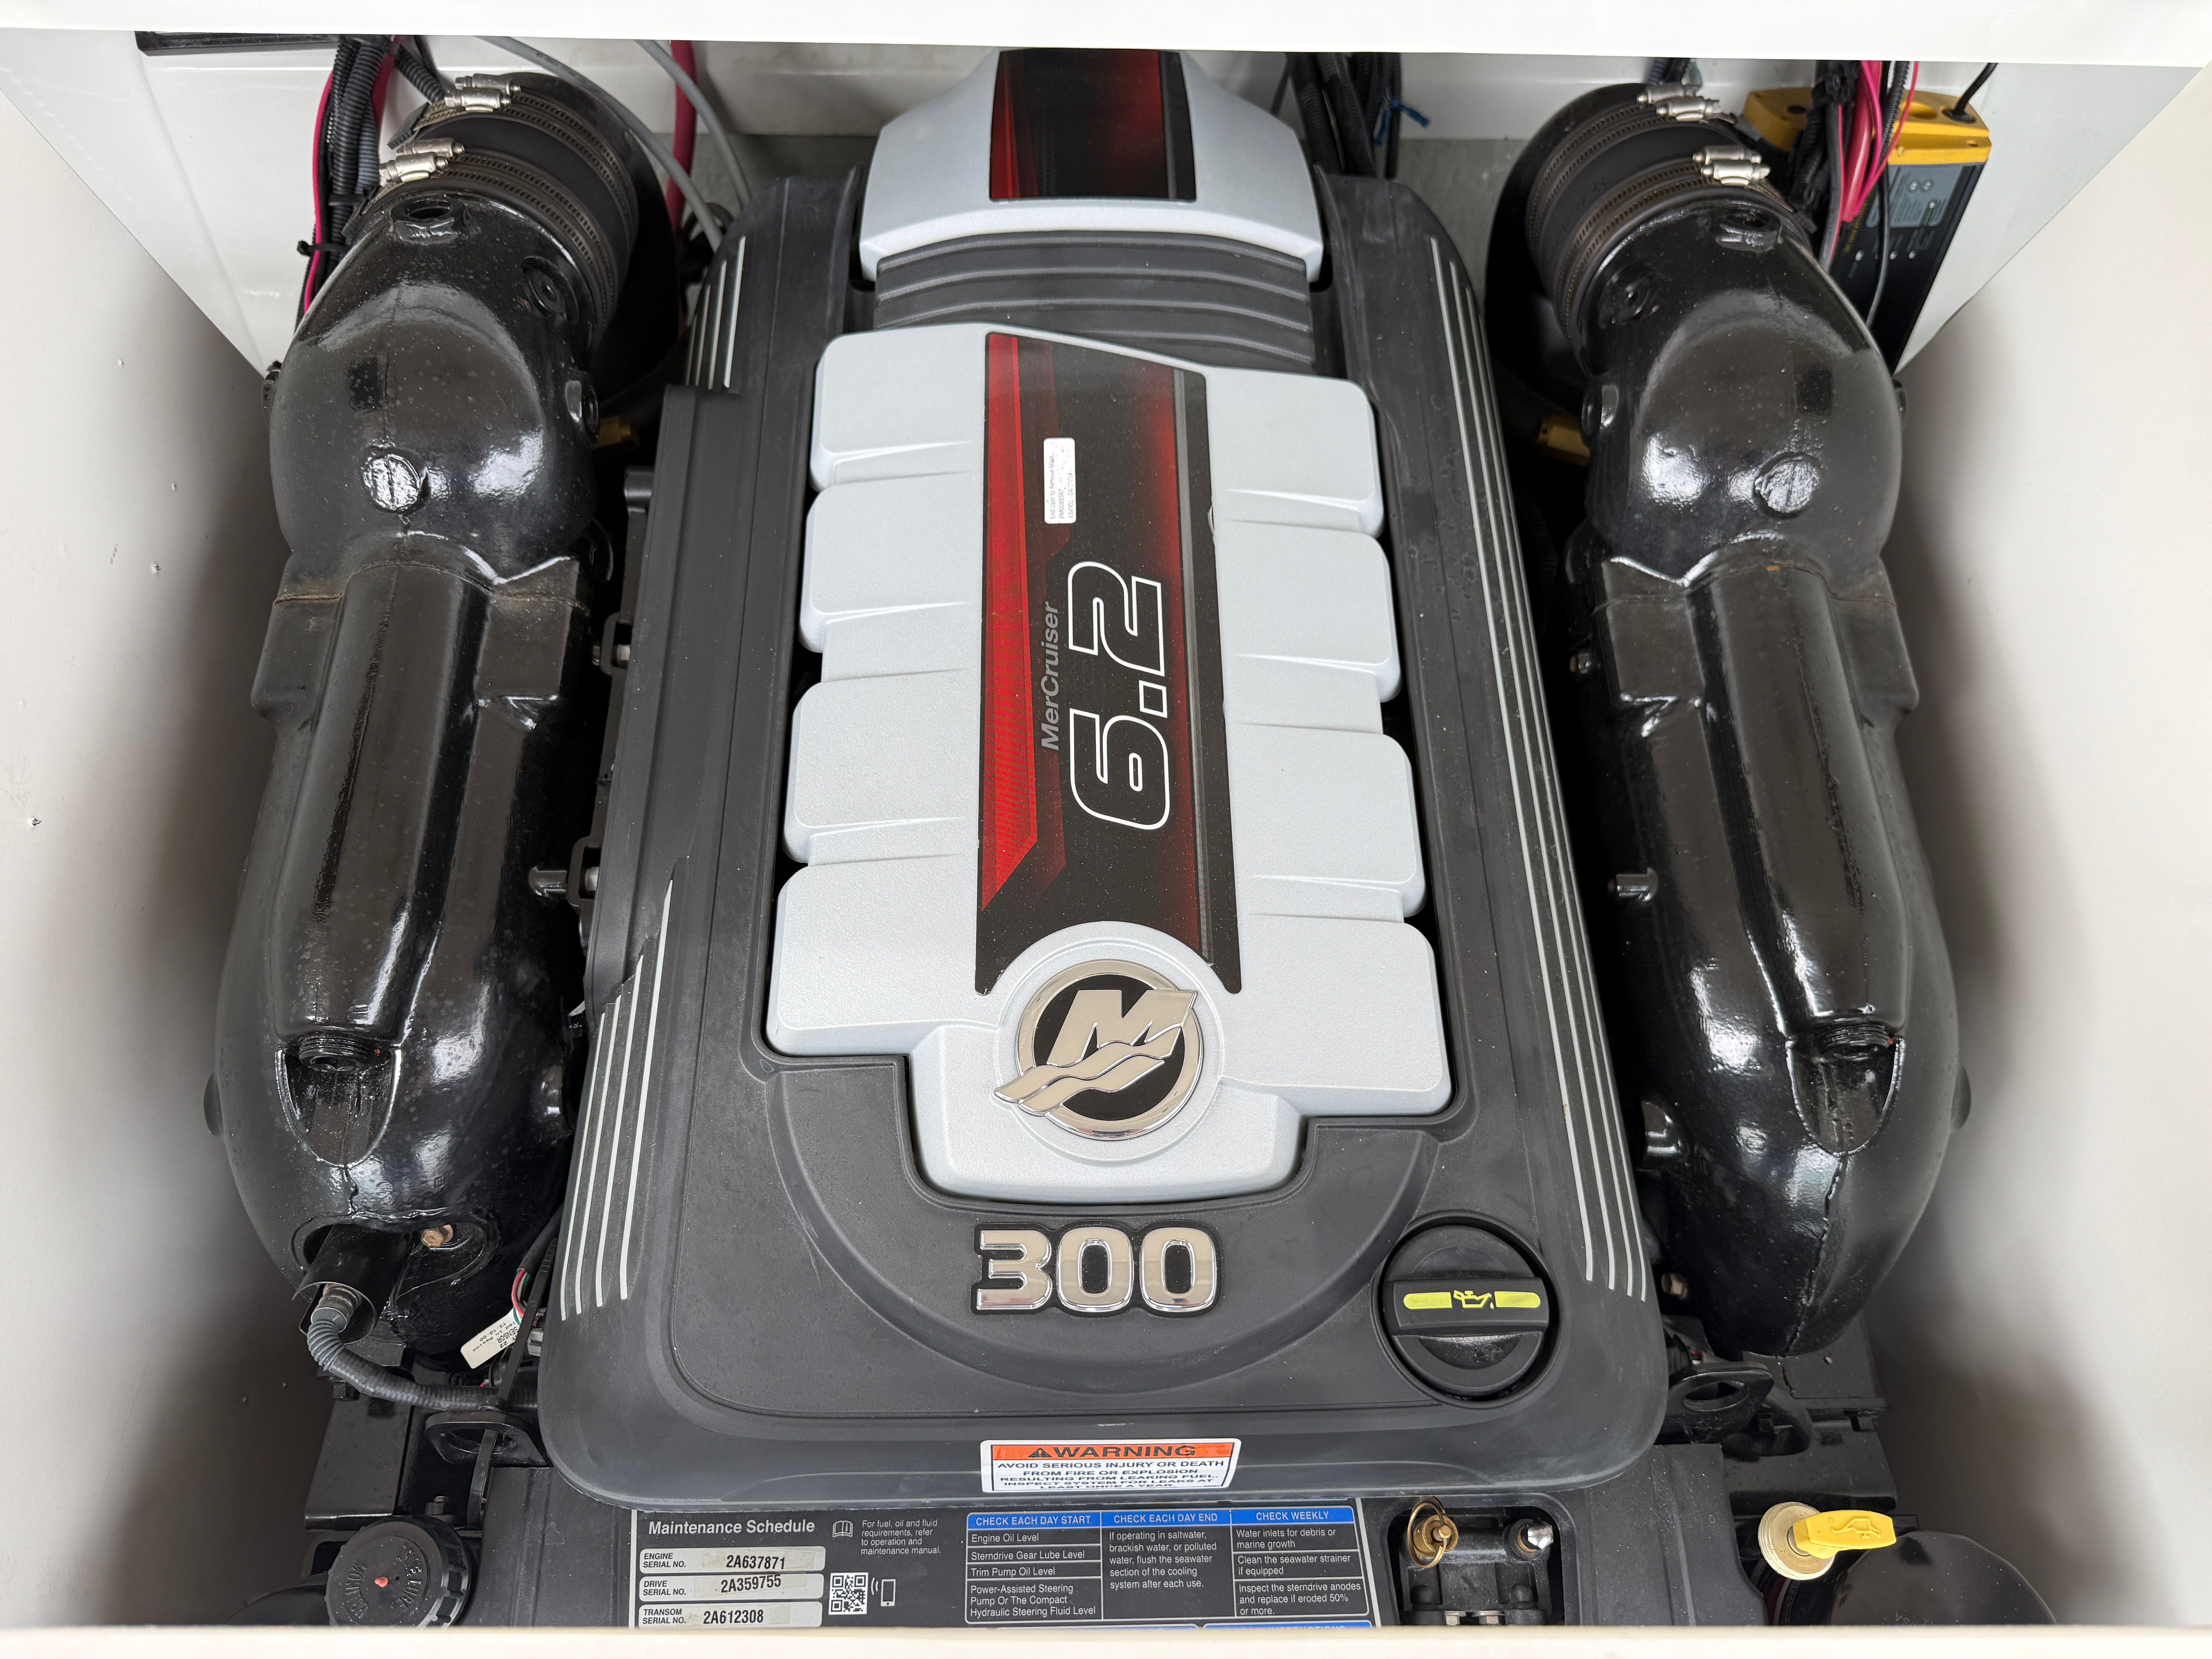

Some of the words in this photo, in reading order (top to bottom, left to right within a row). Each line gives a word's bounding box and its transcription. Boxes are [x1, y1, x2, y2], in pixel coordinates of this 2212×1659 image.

[1041, 601, 1059, 751] MerCruiser
[1067, 561, 1170, 830] 6.2
[975, 1225, 1219, 1314] 300
[497, 1327, 519, 1343] SENSOR
[1053, 1446, 1196, 1457] WARNING
[976, 1517, 1008, 1525] CHECK
[1012, 1516, 1037, 1525] EACH
[1061, 1516, 1091, 1524] START
[1114, 1515, 1146, 1523] CHECK
[1149, 1514, 1175, 1523] EACH
[1178, 1514, 1196, 1522] DAY
[1199, 1513, 1218, 1522] END
[1256, 1512, 1288, 1521] CHECK
[1291, 1511, 1329, 1520] WEEKLY
[648, 1521, 742, 1534] Maintenance
[746, 1519, 815, 1533] Schedule
[877, 1520, 892, 1528] fuel,
[862, 1529, 913, 1538] requirements,
[1109, 1532, 1114, 1540] If
[1117, 1531, 1155, 1541] operating
[1158, 1531, 1165, 1539] in
[1168, 1531, 1206, 1539] saltwater,
[1237, 1529, 1261, 1537] Water
[1263, 1529, 1285, 1537] inlets
[1300, 1528, 1325, 1536] debris
[871, 1538, 905, 1547] operation
[972, 1534, 1000, 1544] Engine
[1003, 1533, 1014, 1542] Oil
[1017, 1533, 1039, 1541] Level
[1109, 1542, 1144, 1552] brackish
[1146, 1544, 1171, 1552] water,
[1185, 1542, 1217, 1552] polluted
[1237, 1540, 1265, 1549] marine
[1268, 1540, 1295, 1550] growth
[971, 1551, 1013, 1561] Sterndrive
[1017, 1551, 1037, 1559] Gear
[1040, 1551, 1060, 1559] Lube
[1063, 1550, 1085, 1558] Level
[1109, 1556, 1134, 1565] water,
[1137, 1555, 1156, 1564] flush
[1159, 1555, 1172, 1563] the
[1175, 1554, 1212, 1563] seawater
[1238, 1555, 1262, 1564] Clean
[1264, 1555, 1277, 1563] the
[1280, 1555, 1317, 1563] seawater
[1320, 1554, 1351, 1562] strainer
[726, 1554, 785, 1570] 2A637871
[971, 1568, 989, 1577] Trim
[992, 1568, 1016, 1577] Pump
[1019, 1567, 1030, 1576] Oil
[1033, 1567, 1055, 1575] Level
[1110, 1568, 1139, 1577] section
[1142, 1568, 1150, 1576] of
[1152, 1567, 1165, 1575] the
[1168, 1567, 1197, 1577] cooling
[1238, 1567, 1243, 1575] if
[1246, 1566, 1283, 1577] equipped
[721, 1574, 781, 1593] 2A359755
[971, 1584, 1036, 1594] Power-Assisted
[1039, 1584, 1073, 1594] Steering
[1110, 1580, 1139, 1591] system
[1142, 1580, 1161, 1588] after
[1164, 1579, 1183, 1587] each
[1239, 1584, 1269, 1593] Inspect
[1271, 1583, 1284, 1592] the
[1287, 1583, 1328, 1592] sterndrive
[1330, 1582, 1361, 1590] anodes
[971, 1597, 995, 1606] Pump
[998, 1596, 1008, 1604] Or
[1011, 1596, 1027, 1604] The
[1030, 1595, 1067, 1606] Compact
[1240, 1595, 1255, 1604] and
[1258, 1595, 1288, 1605] replace
[1291, 1594, 1295, 1602] if
[1298, 1594, 1327, 1602] eroded
[1330, 1594, 1348, 1602] 50%
[703, 1609, 764, 1625] 2A612308
[970, 1607, 1010, 1619] Hydraulic
[1012, 1607, 1047, 1618] Steering
[1050, 1606, 1070, 1615] Fluid
[1073, 1606, 1096, 1614] Level
